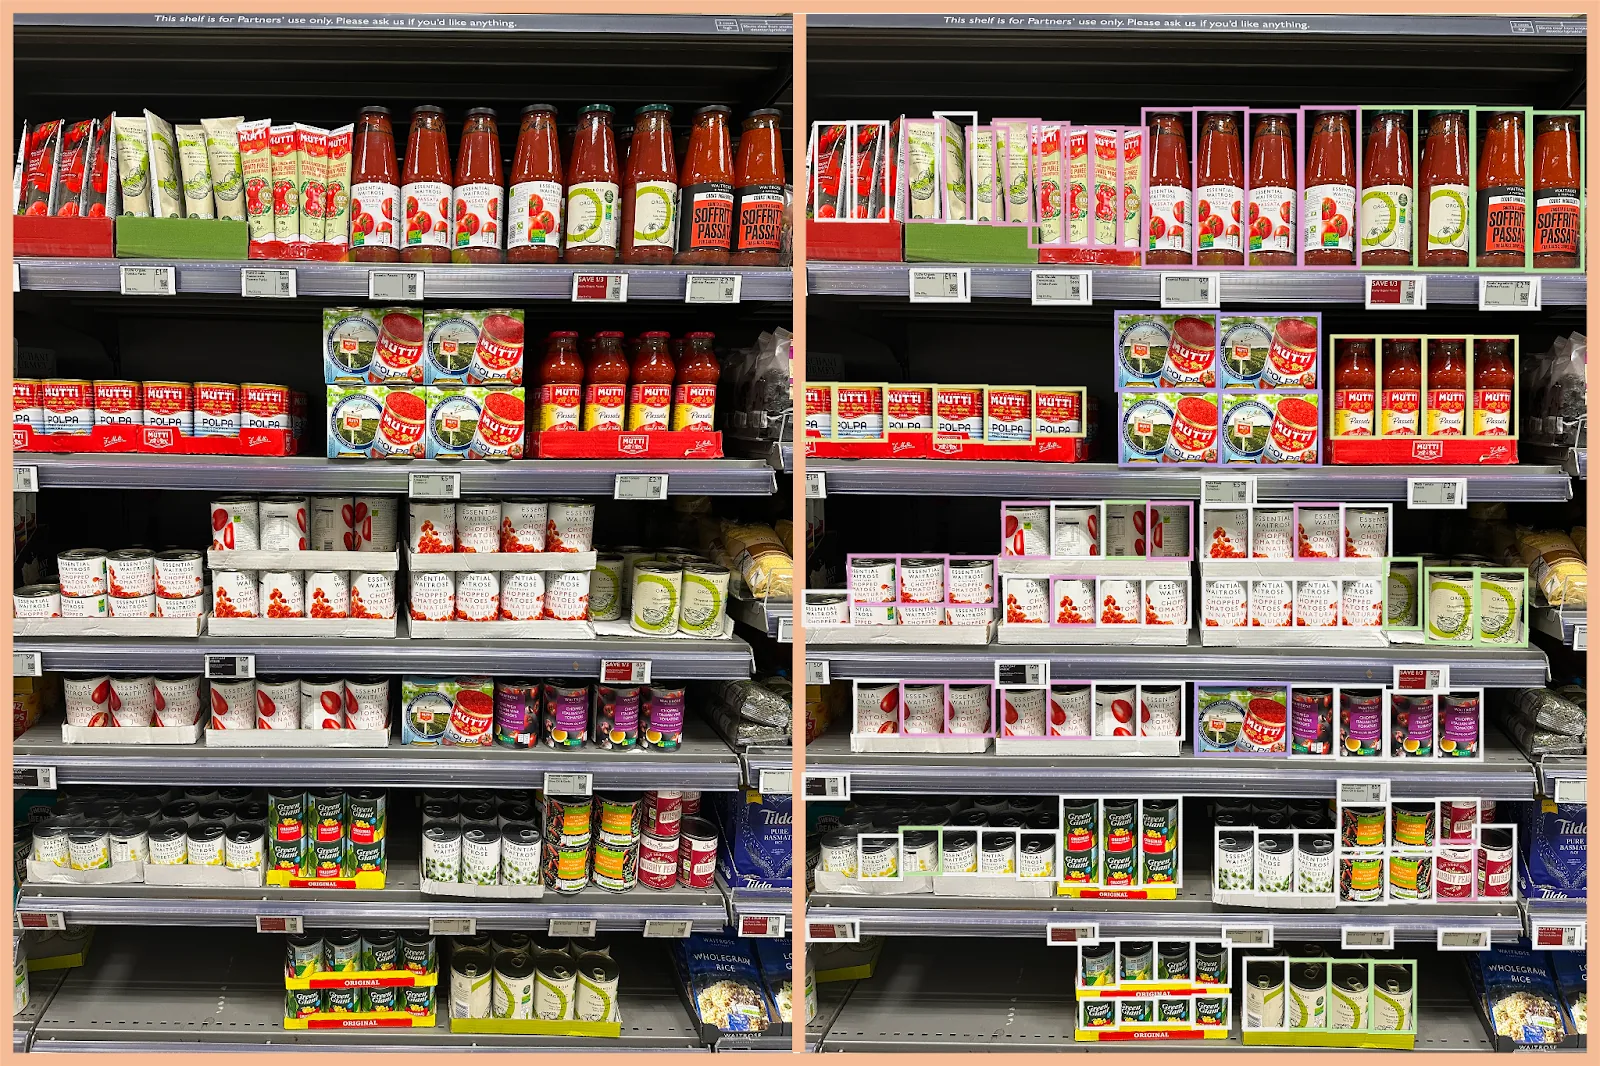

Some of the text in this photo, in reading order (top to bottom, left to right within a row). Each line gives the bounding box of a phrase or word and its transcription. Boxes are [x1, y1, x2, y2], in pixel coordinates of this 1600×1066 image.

[309, 17, 333, 26] only.
[336, 17, 369, 25] Please
[372, 18, 389, 26] ask
[417, 18, 445, 27] you'd
[449, 18, 467, 27] like
[470, 19, 517, 28] anything.
[1100, 18, 1124, 27] only.
[1127, 18, 1161, 27] Please
[1164, 19, 1181, 27] ask
[1209, 20, 1237, 29] you'd
[1241, 20, 1259, 28] like
[1262, 20, 1310, 30] anything.
[240, 131, 266, 142] MUTTI
[300, 134, 326, 146] MUTTI
[381, 336, 419, 357] MUTTI
[480, 337, 518, 358] MUTTI
[1173, 341, 1211, 362] MUTTI
[1273, 341, 1311, 363] MUTTI
[45, 387, 79, 397] MUTTI
[98, 388, 132, 398] MUTTI
[148, 389, 182, 400] MUTTI
[201, 390, 234, 401] MUTTI
[249, 391, 281, 402] MUTTI
[597, 389, 624, 397] MUTTI
[644, 389, 670, 397] MUTTI
[690, 389, 715, 397] MUTTI
[937, 394, 972, 405] MUTTI
[991, 395, 1024, 406] MUTTI
[1039, 397, 1072, 408] MUTTI
[1391, 394, 1418, 402] MUTTI
[1438, 394, 1464, 402] MUTTI
[1485, 394, 1510, 402] MUTTI
[150, 417, 182, 426] POLPA
[202, 419, 233, 427] POLPA
[250, 420, 280, 428] POLPA
[384, 414, 420, 435] MUTTI
[482, 415, 519, 435] MUTTI
[940, 423, 971, 432] POLPA
[992, 424, 1023, 433] POLPA
[1040, 425, 1070, 434] POLPA
[1175, 420, 1212, 440] MUTTI
[1275, 420, 1312, 441] MUTTI
[454, 709, 488, 727] MUTTI
[1246, 718, 1281, 736] MUTTI
[278, 803, 300, 811] Green
[318, 803, 341, 811] Green
[351, 804, 373, 812] Green
[744, 879, 772, 888] Tilda
[1539, 890, 1568, 899] Tilda
[375, 946, 396, 957] Green
[404, 947, 425, 957] Green
[694, 953, 751, 965] WHOLEGRAIN
[716, 964, 736, 972] RICE
[1488, 964, 1546, 976] WHOLEGRAIN
[1511, 975, 1531, 984] RICE
[297, 992, 318, 1001] Green
[329, 991, 351, 1001] Green
[371, 991, 391, 999] Green
[406, 990, 427, 999] Green
[298, 997, 319, 1005] Giant
